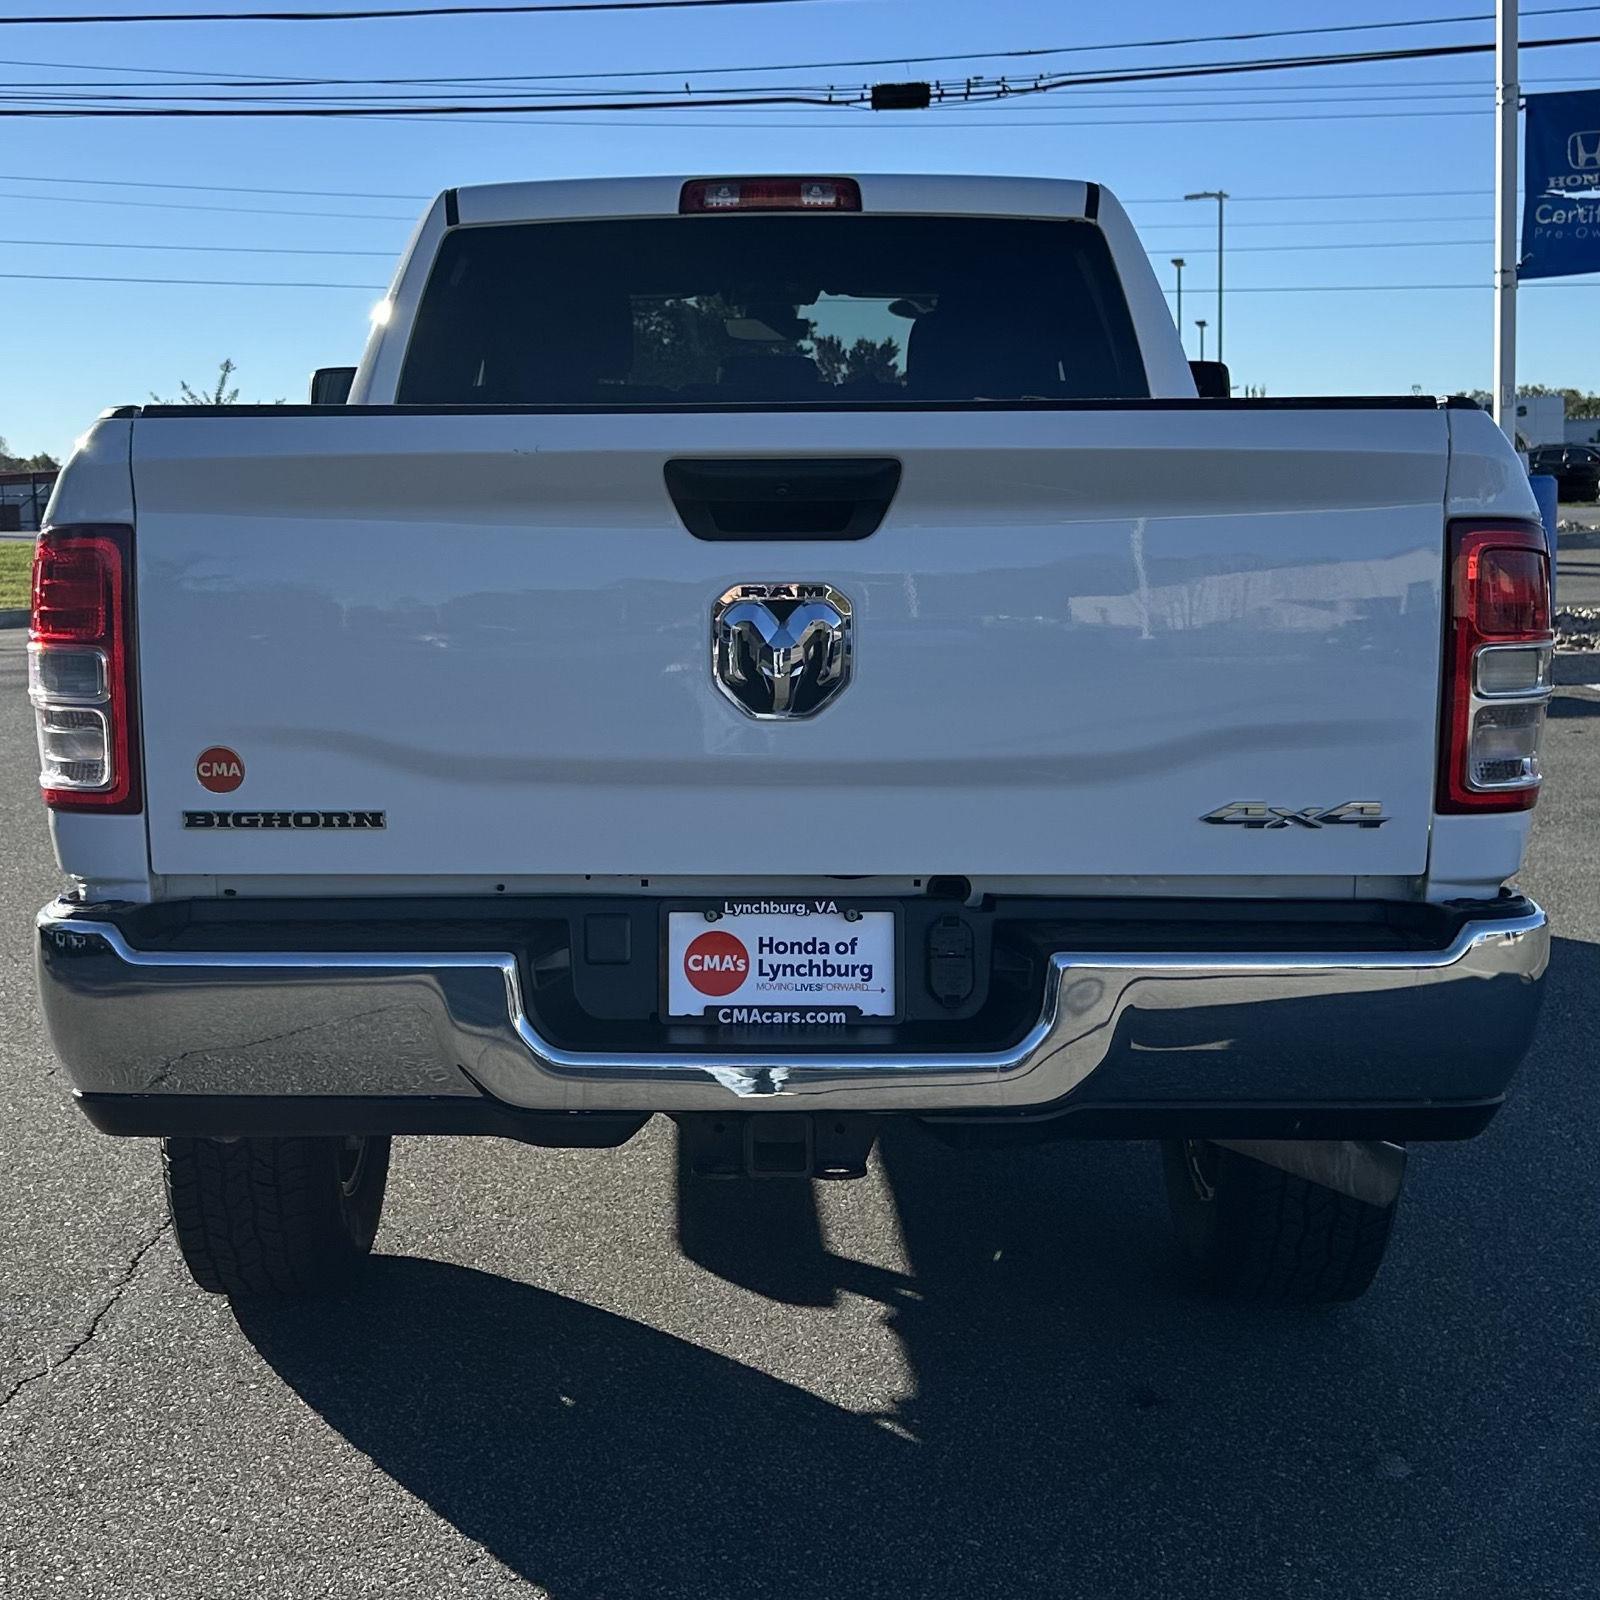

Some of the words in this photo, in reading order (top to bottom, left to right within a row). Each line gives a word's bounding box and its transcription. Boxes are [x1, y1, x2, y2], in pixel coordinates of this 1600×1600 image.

[740, 586, 824, 598] RAM
[198, 762, 241, 777] CMA
[183, 811, 386, 829] BIGHORN
[1199, 801, 1392, 829] 4x4
[724, 901, 811, 916] Lynchburg,
[815, 901, 838, 914] VA
[758, 936, 832, 955] Honda
[835, 936, 859, 955] of
[687, 955, 746, 972] CMA's
[758, 959, 873, 982] Lynchburg
[718, 1008, 847, 1024] CMAcars.com
